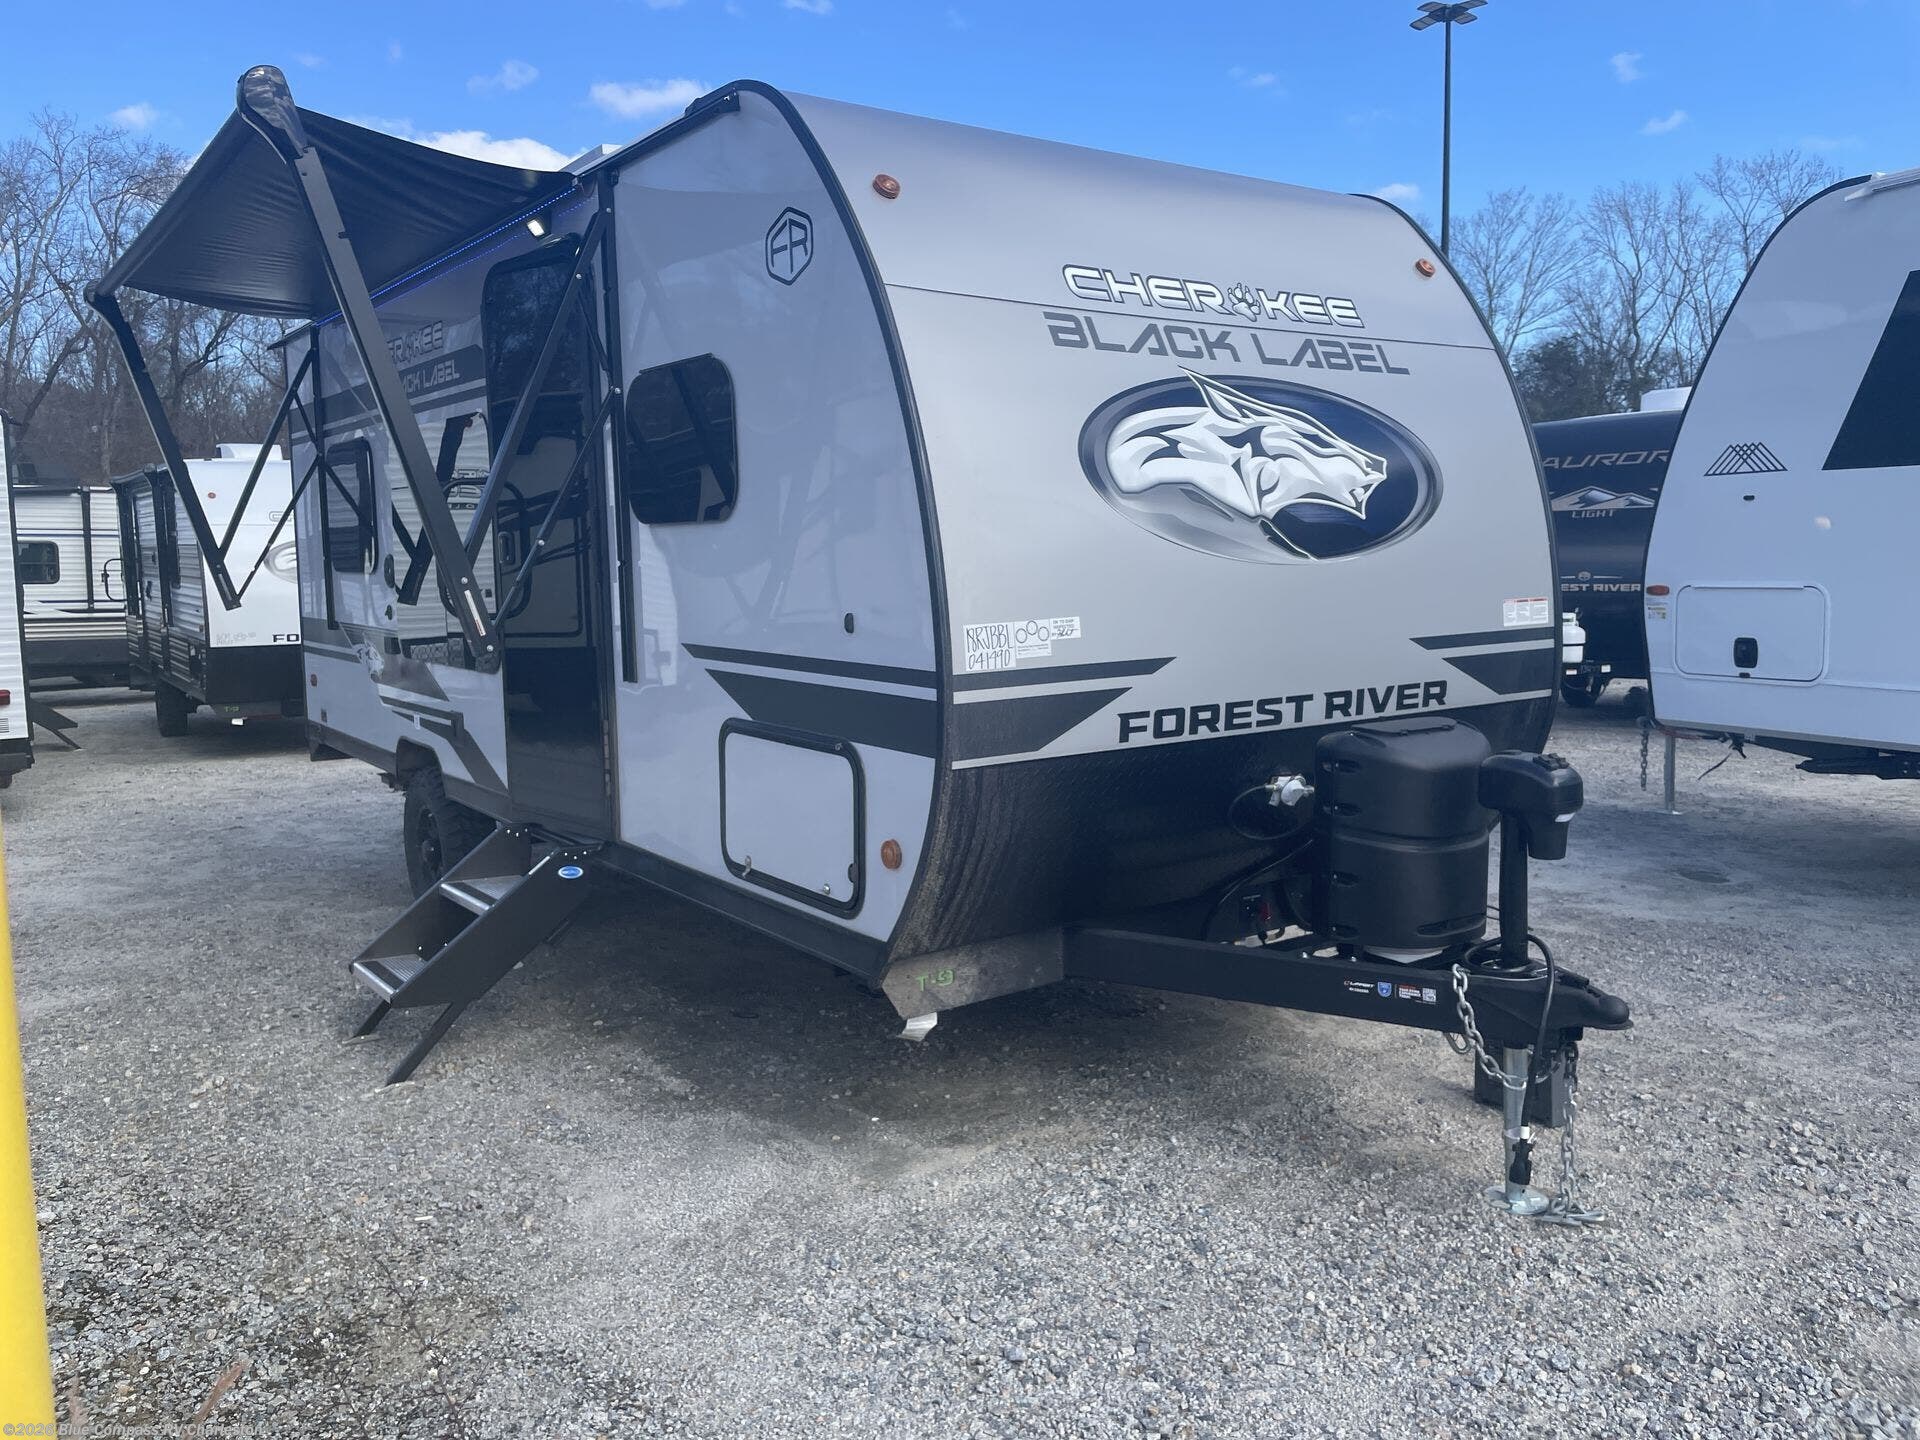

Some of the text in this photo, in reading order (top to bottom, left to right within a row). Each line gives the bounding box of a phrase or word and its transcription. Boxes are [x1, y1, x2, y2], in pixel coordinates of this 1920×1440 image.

[1043, 311, 1410, 375] BLACK LABEL
[422, 359, 460, 389] LABEL
[1543, 449, 1670, 469] AUROR
[1571, 509, 1617, 519] LIGHT
[1560, 583, 1642, 592] EST RIVER
[1117, 680, 1449, 743] FOREST RIVER
